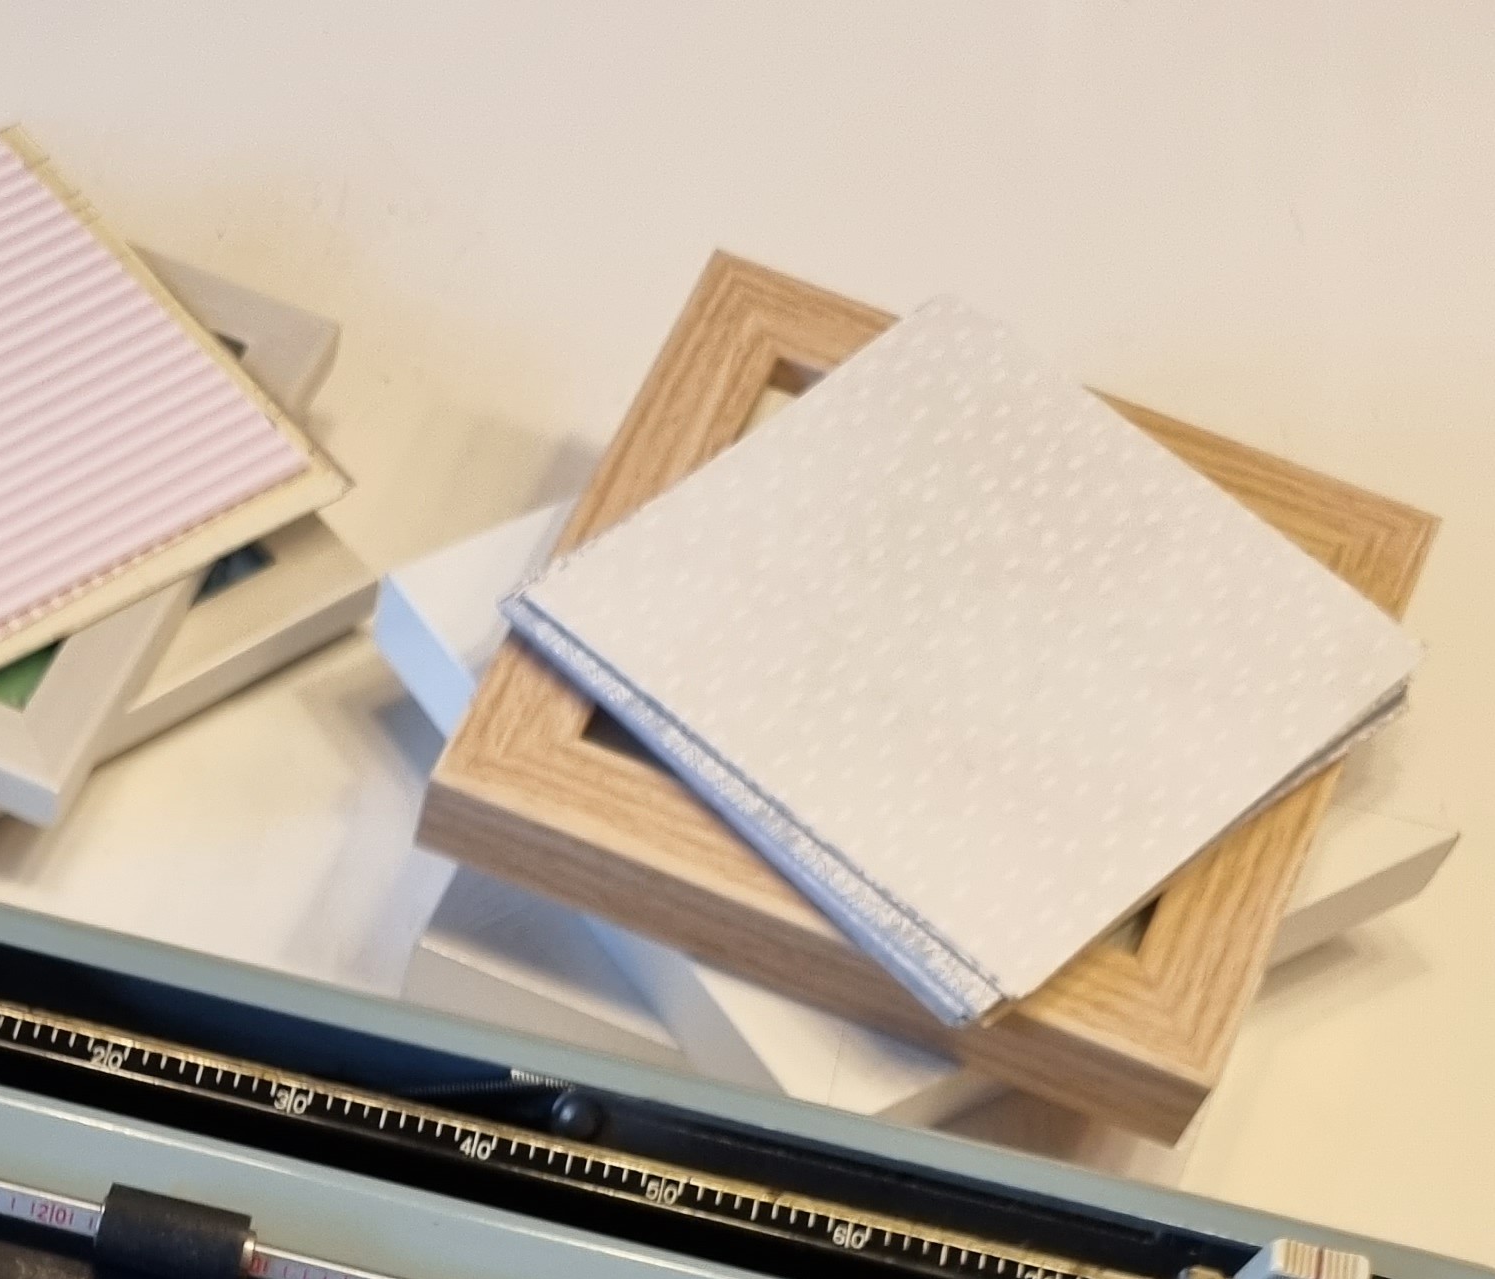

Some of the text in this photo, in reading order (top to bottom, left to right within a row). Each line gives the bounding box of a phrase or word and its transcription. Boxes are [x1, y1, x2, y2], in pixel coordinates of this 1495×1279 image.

[89, 1044, 124, 1070] 20
[274, 1089, 308, 1115] 30
[460, 1136, 492, 1160] 40
[645, 1179, 679, 1206] 50
[832, 1224, 866, 1249] 60
[37, 1203, 67, 1226] 20
